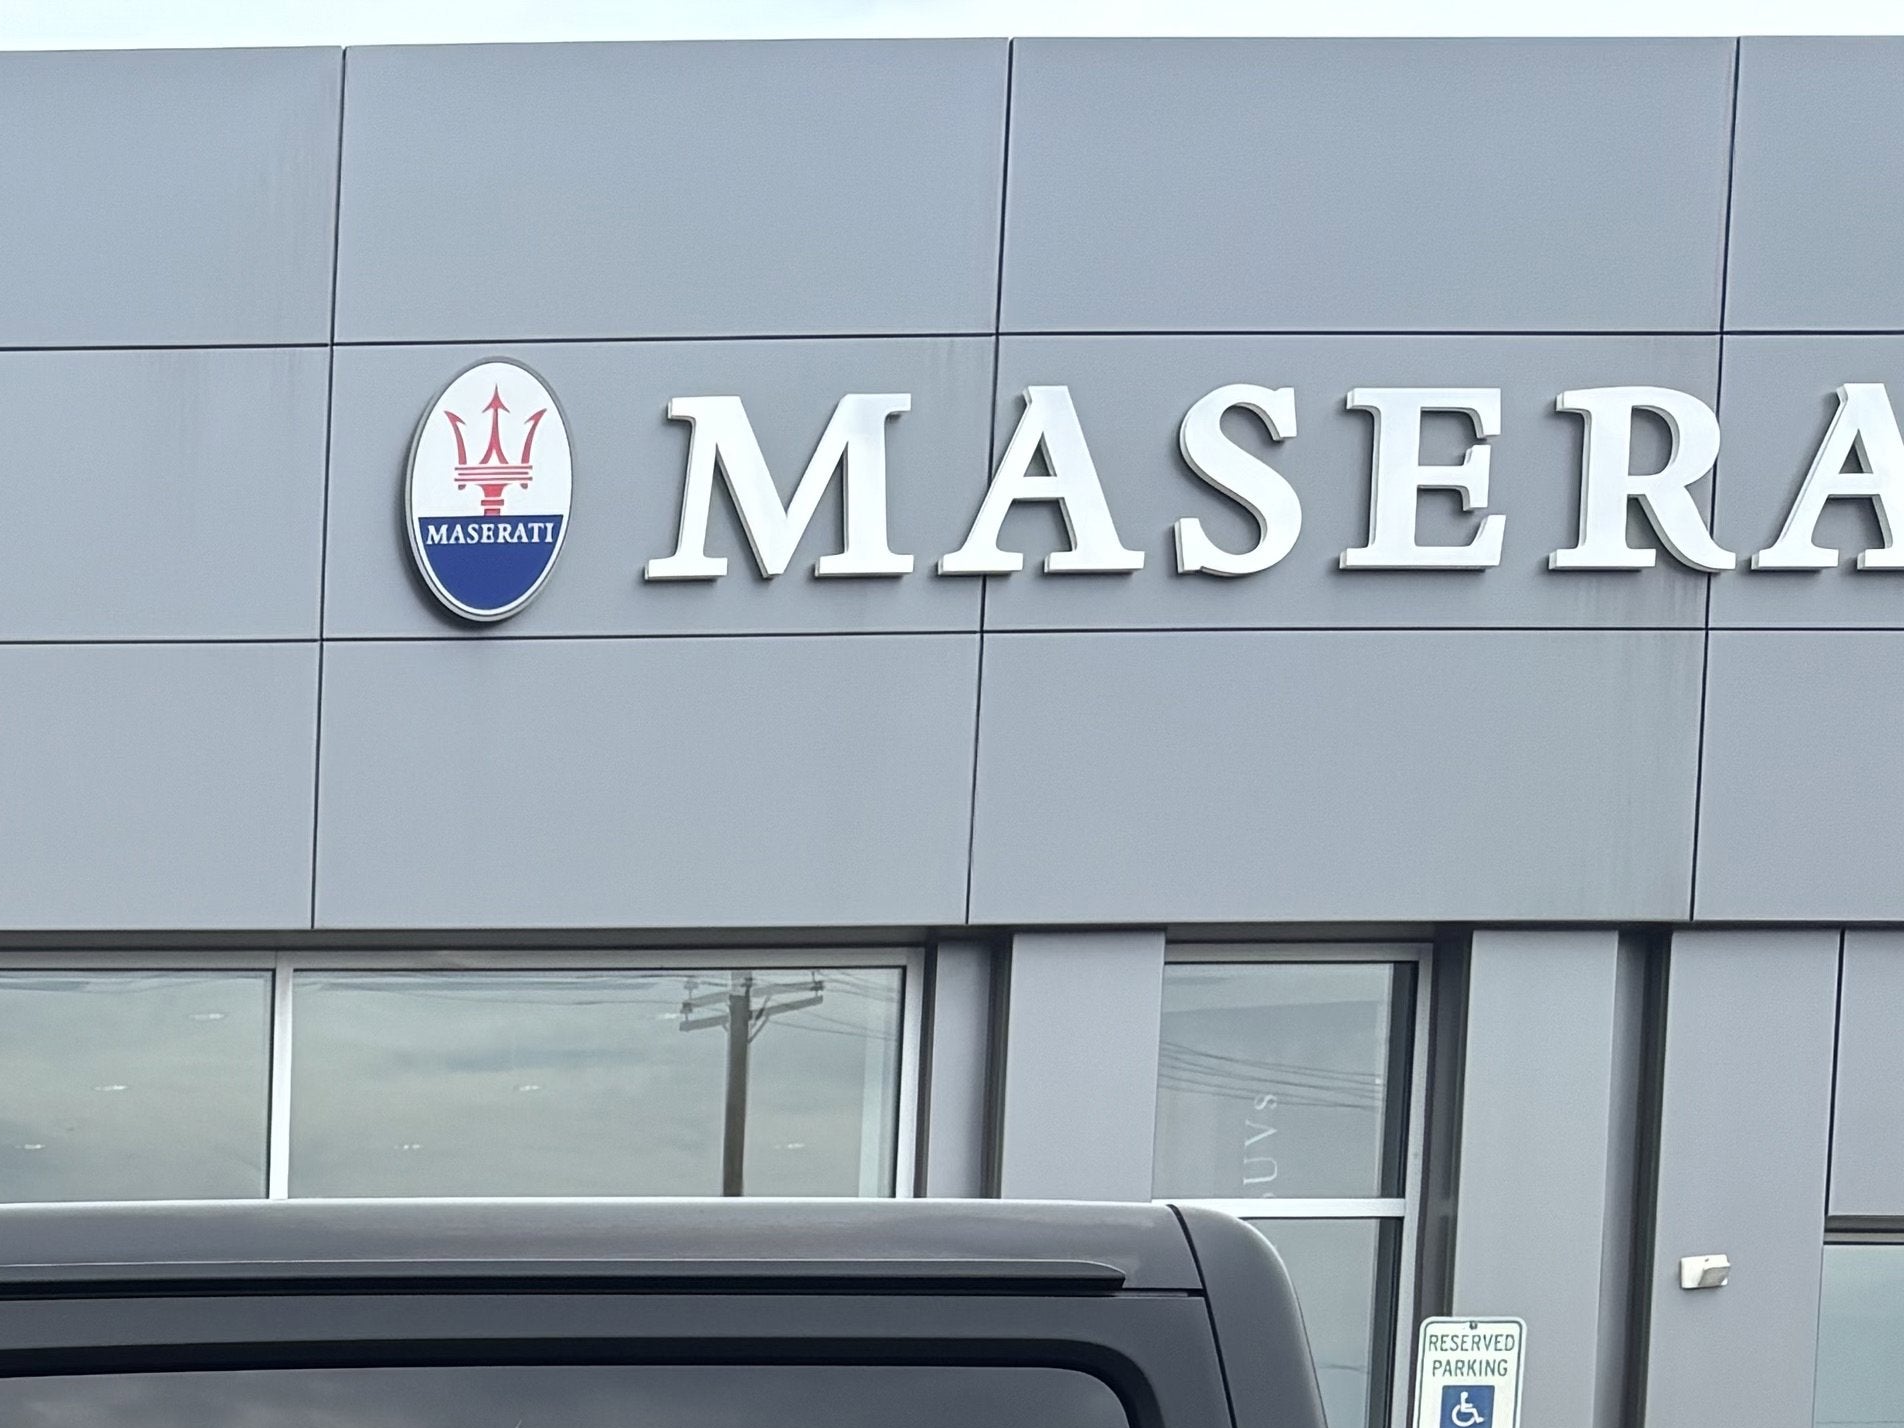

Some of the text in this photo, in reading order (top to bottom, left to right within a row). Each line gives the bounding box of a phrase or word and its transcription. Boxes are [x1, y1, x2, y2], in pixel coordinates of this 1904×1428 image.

[643, 382, 1904, 581] MASERA
[425, 522, 554, 545] MASERATI
[1242, 1094, 1277, 1198] UVs
[1428, 1334, 1515, 1352] RESERVED
[1432, 1359, 1508, 1377] PARKING
